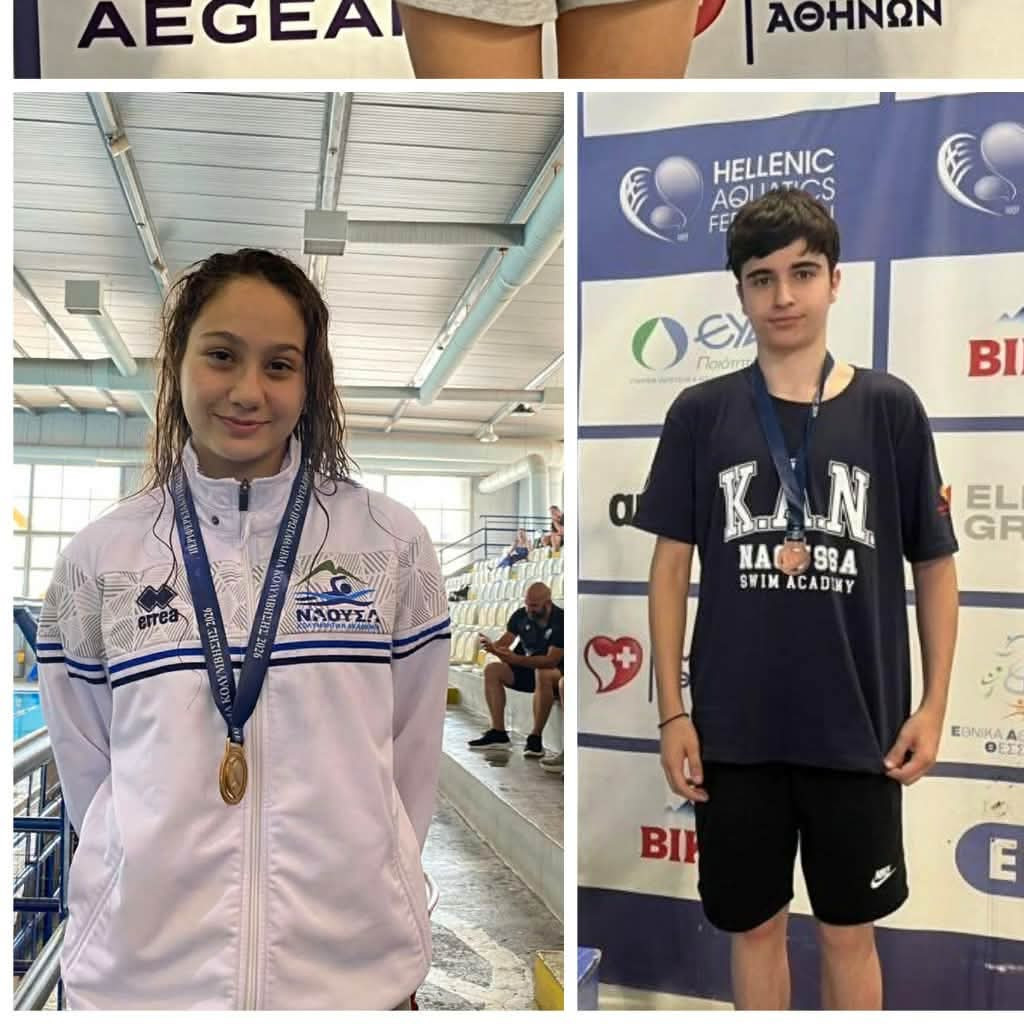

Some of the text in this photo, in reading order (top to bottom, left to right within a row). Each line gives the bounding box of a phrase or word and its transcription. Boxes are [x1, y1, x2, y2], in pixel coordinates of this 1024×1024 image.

[713, 147, 835, 185] HELLENIC
[275, 510, 299, 570] ΠΡΩΤΑΘΛΗΜΑ
[740, 574, 779, 589] SWIM
[257, 569, 284, 637] ΚΟΛΥΜΒΗΣΗΣ
[138, 608, 179, 630] errea
[202, 606, 216, 627] 2026
[252, 636, 266, 660] 2026
[206, 627, 231, 704] ΚΟΛΥΜΒΗΣΗΣ
[951, 725, 1001, 741] ΕΘΝΙΚΑ
